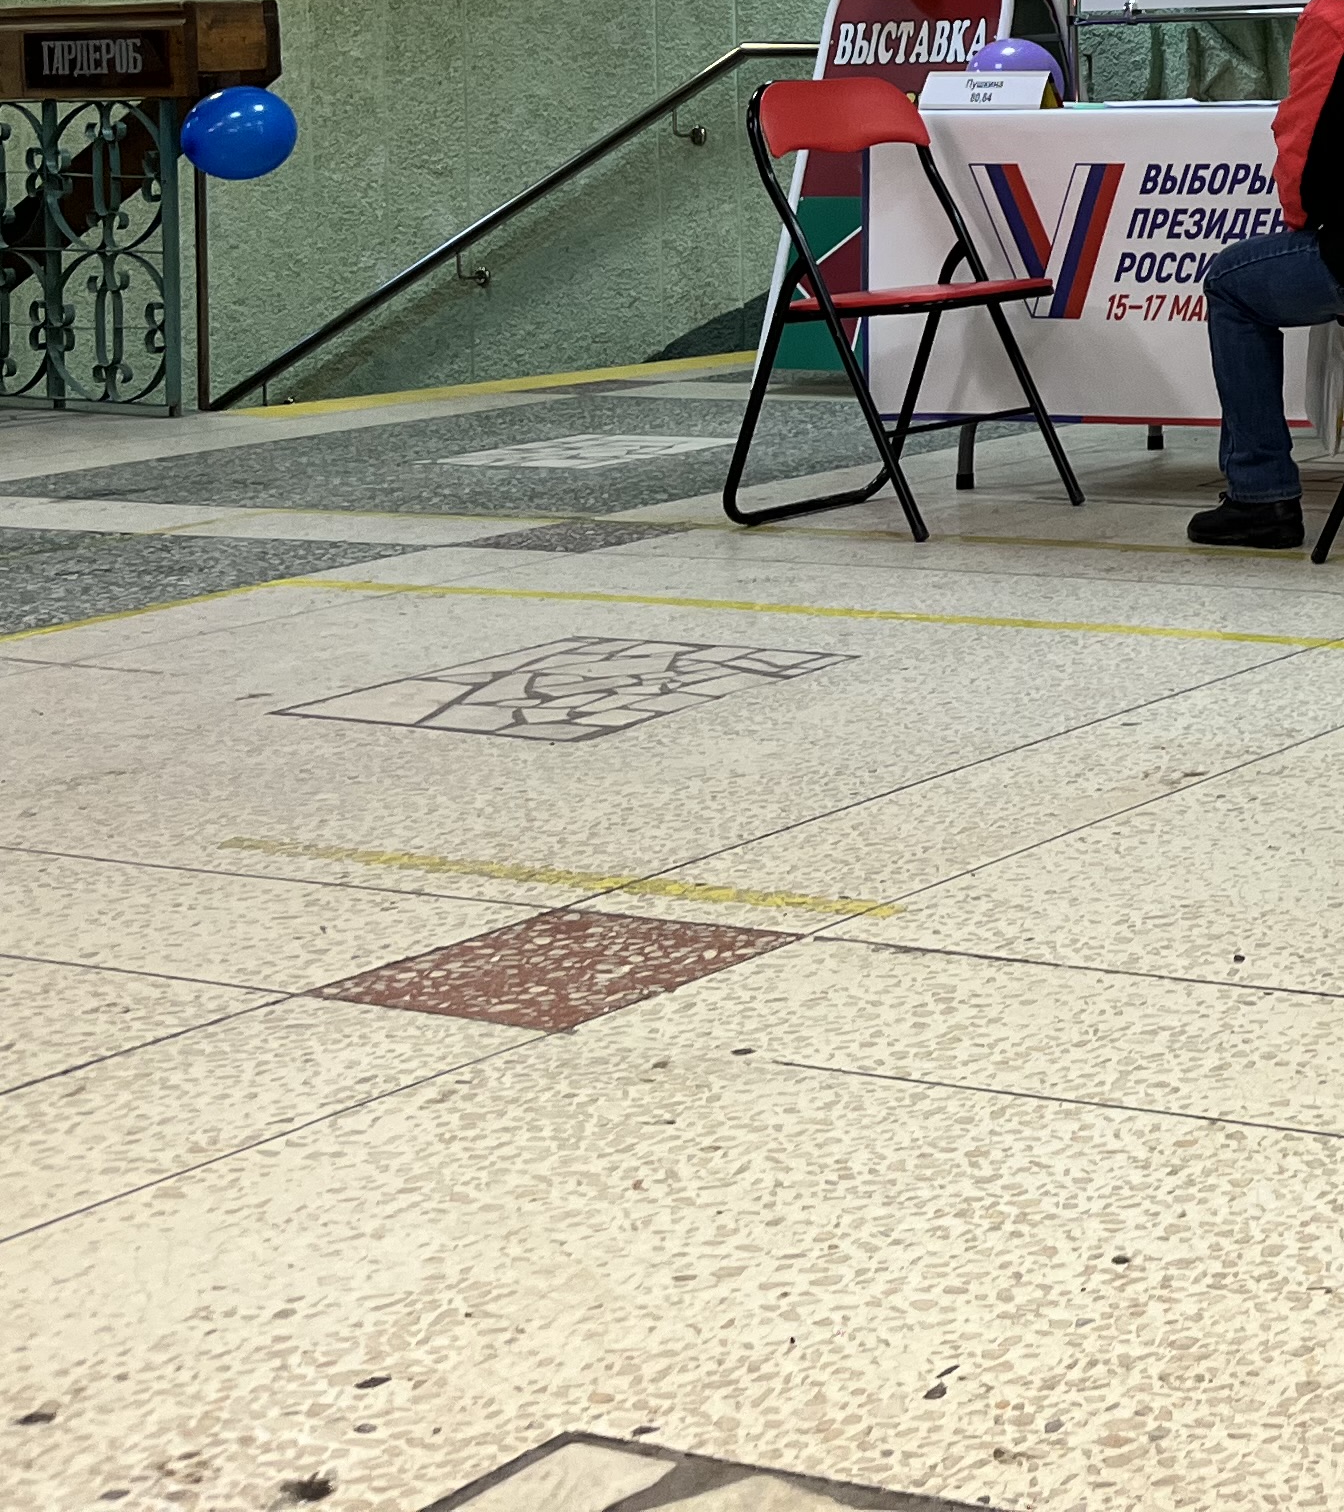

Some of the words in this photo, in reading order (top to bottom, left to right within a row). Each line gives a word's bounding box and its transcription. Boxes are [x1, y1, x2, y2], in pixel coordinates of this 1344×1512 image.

[41, 38, 143, 77] ГАРДЕРОБ
[833, 17, 988, 66] ВЫСТАВКА
[1126, 207, 1286, 245] ПРЕЗИДЕН
[1114, 252, 1218, 284] РОССИ
